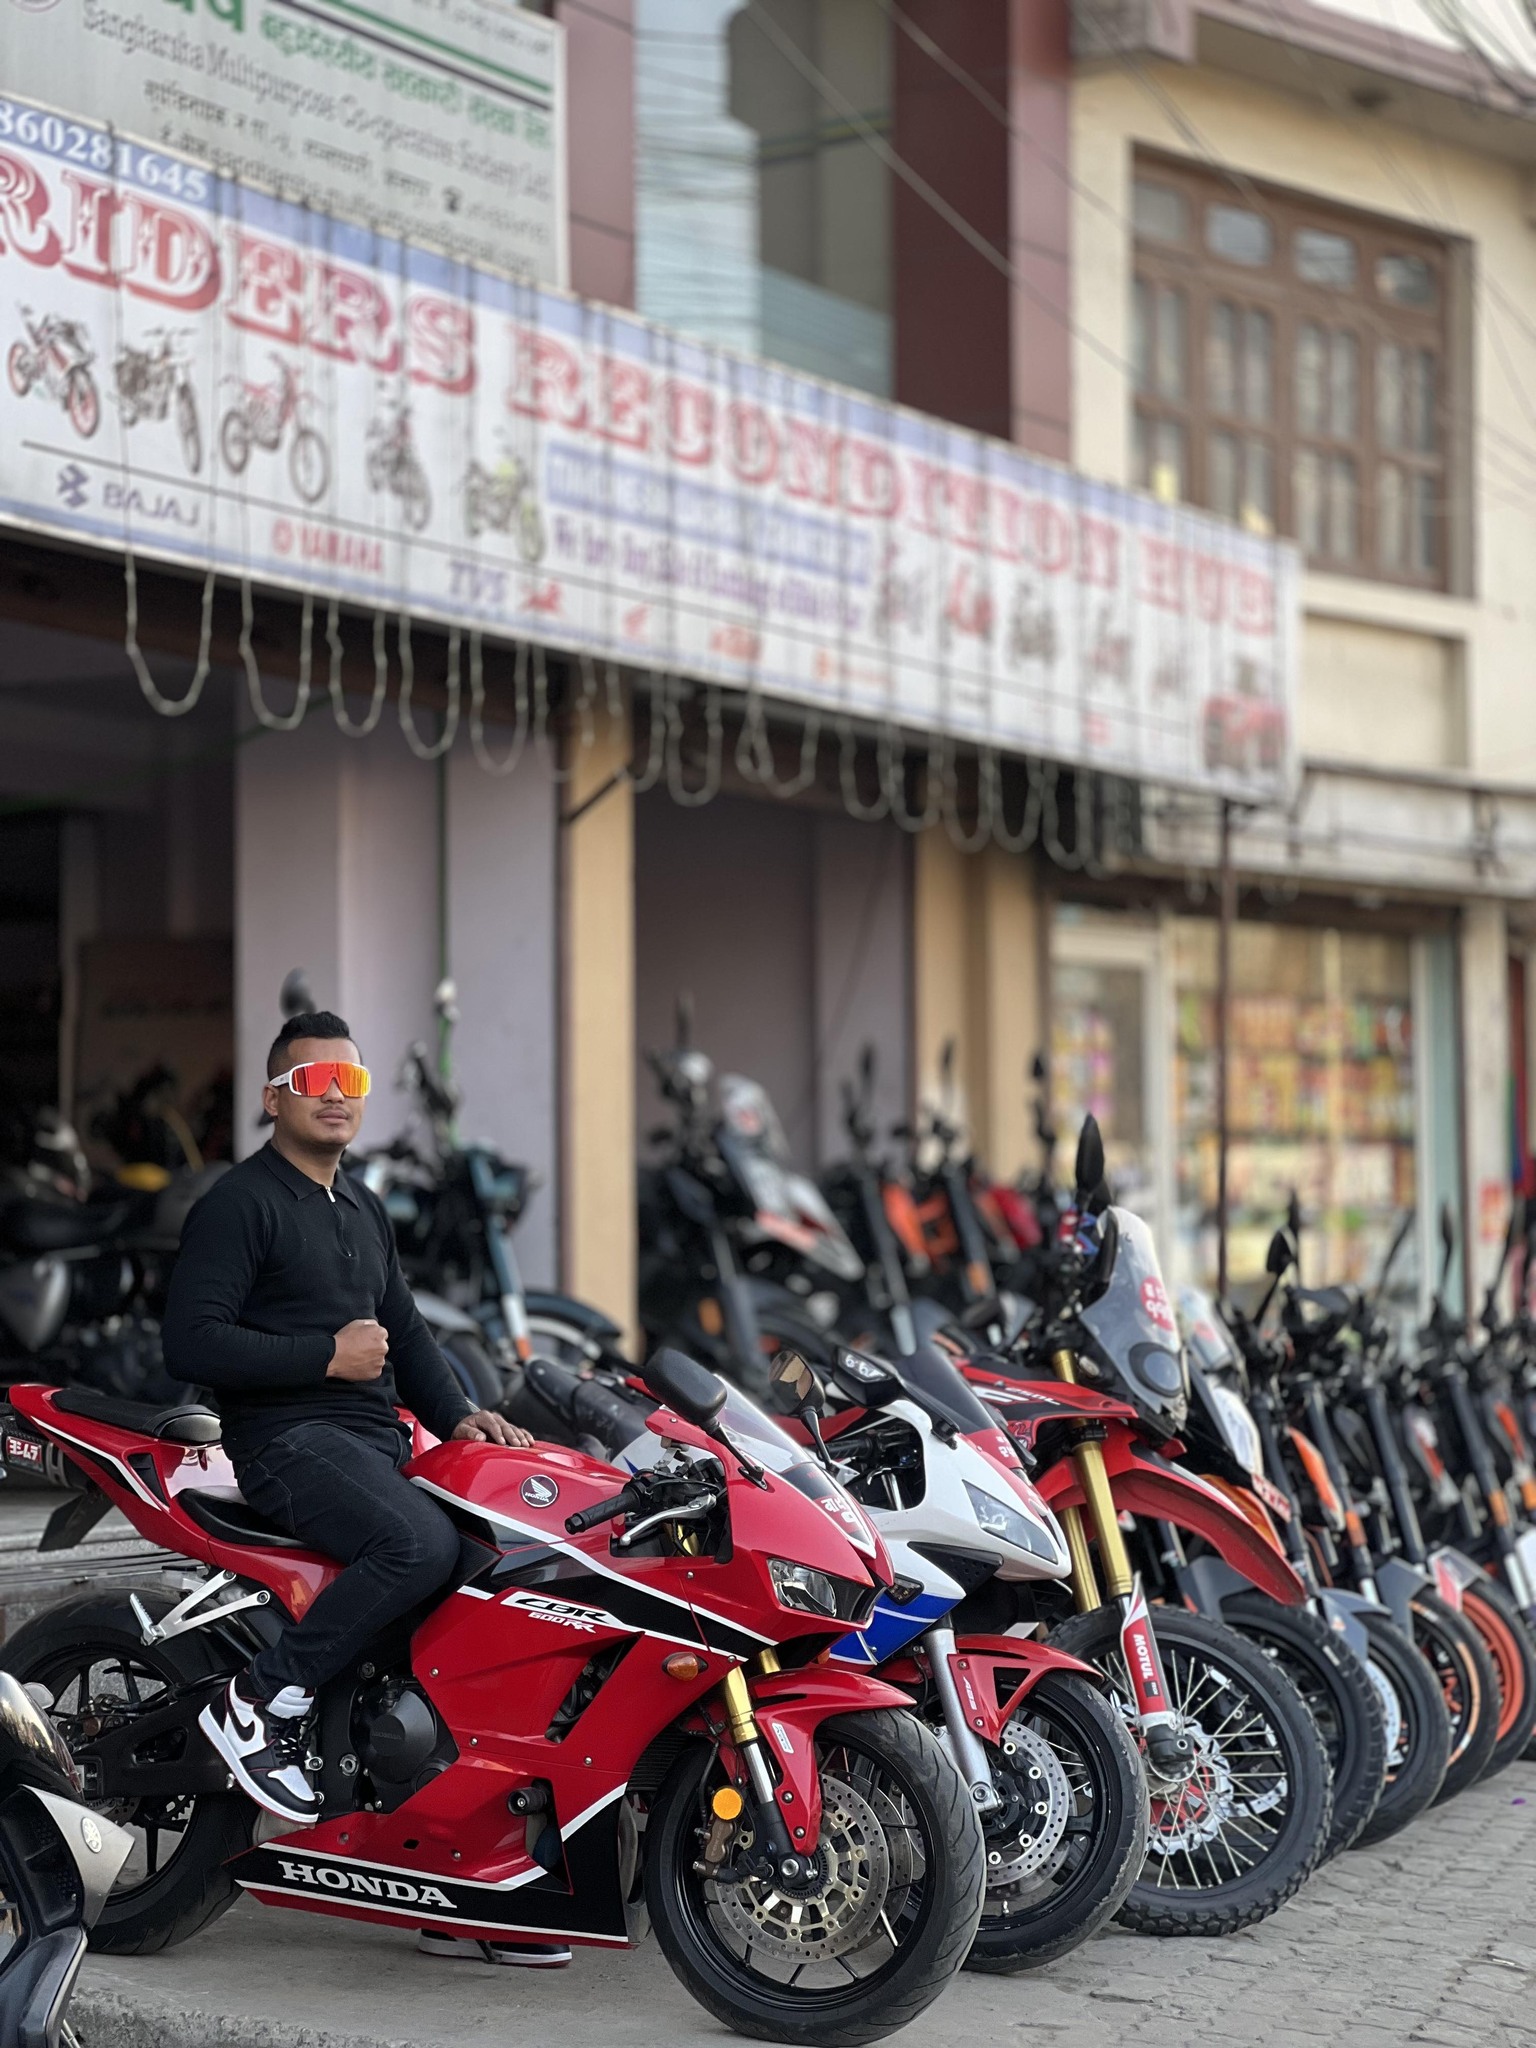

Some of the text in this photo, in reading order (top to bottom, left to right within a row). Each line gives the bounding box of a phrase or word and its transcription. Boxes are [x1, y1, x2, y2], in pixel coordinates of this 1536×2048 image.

[0, 150, 477, 396] RIDERS
[515, 1598, 610, 1625] CBR
[528, 1611, 597, 1634] 600RR
[1132, 1632, 1155, 1680] MOTUL
[278, 1860, 458, 1910] HONDA
